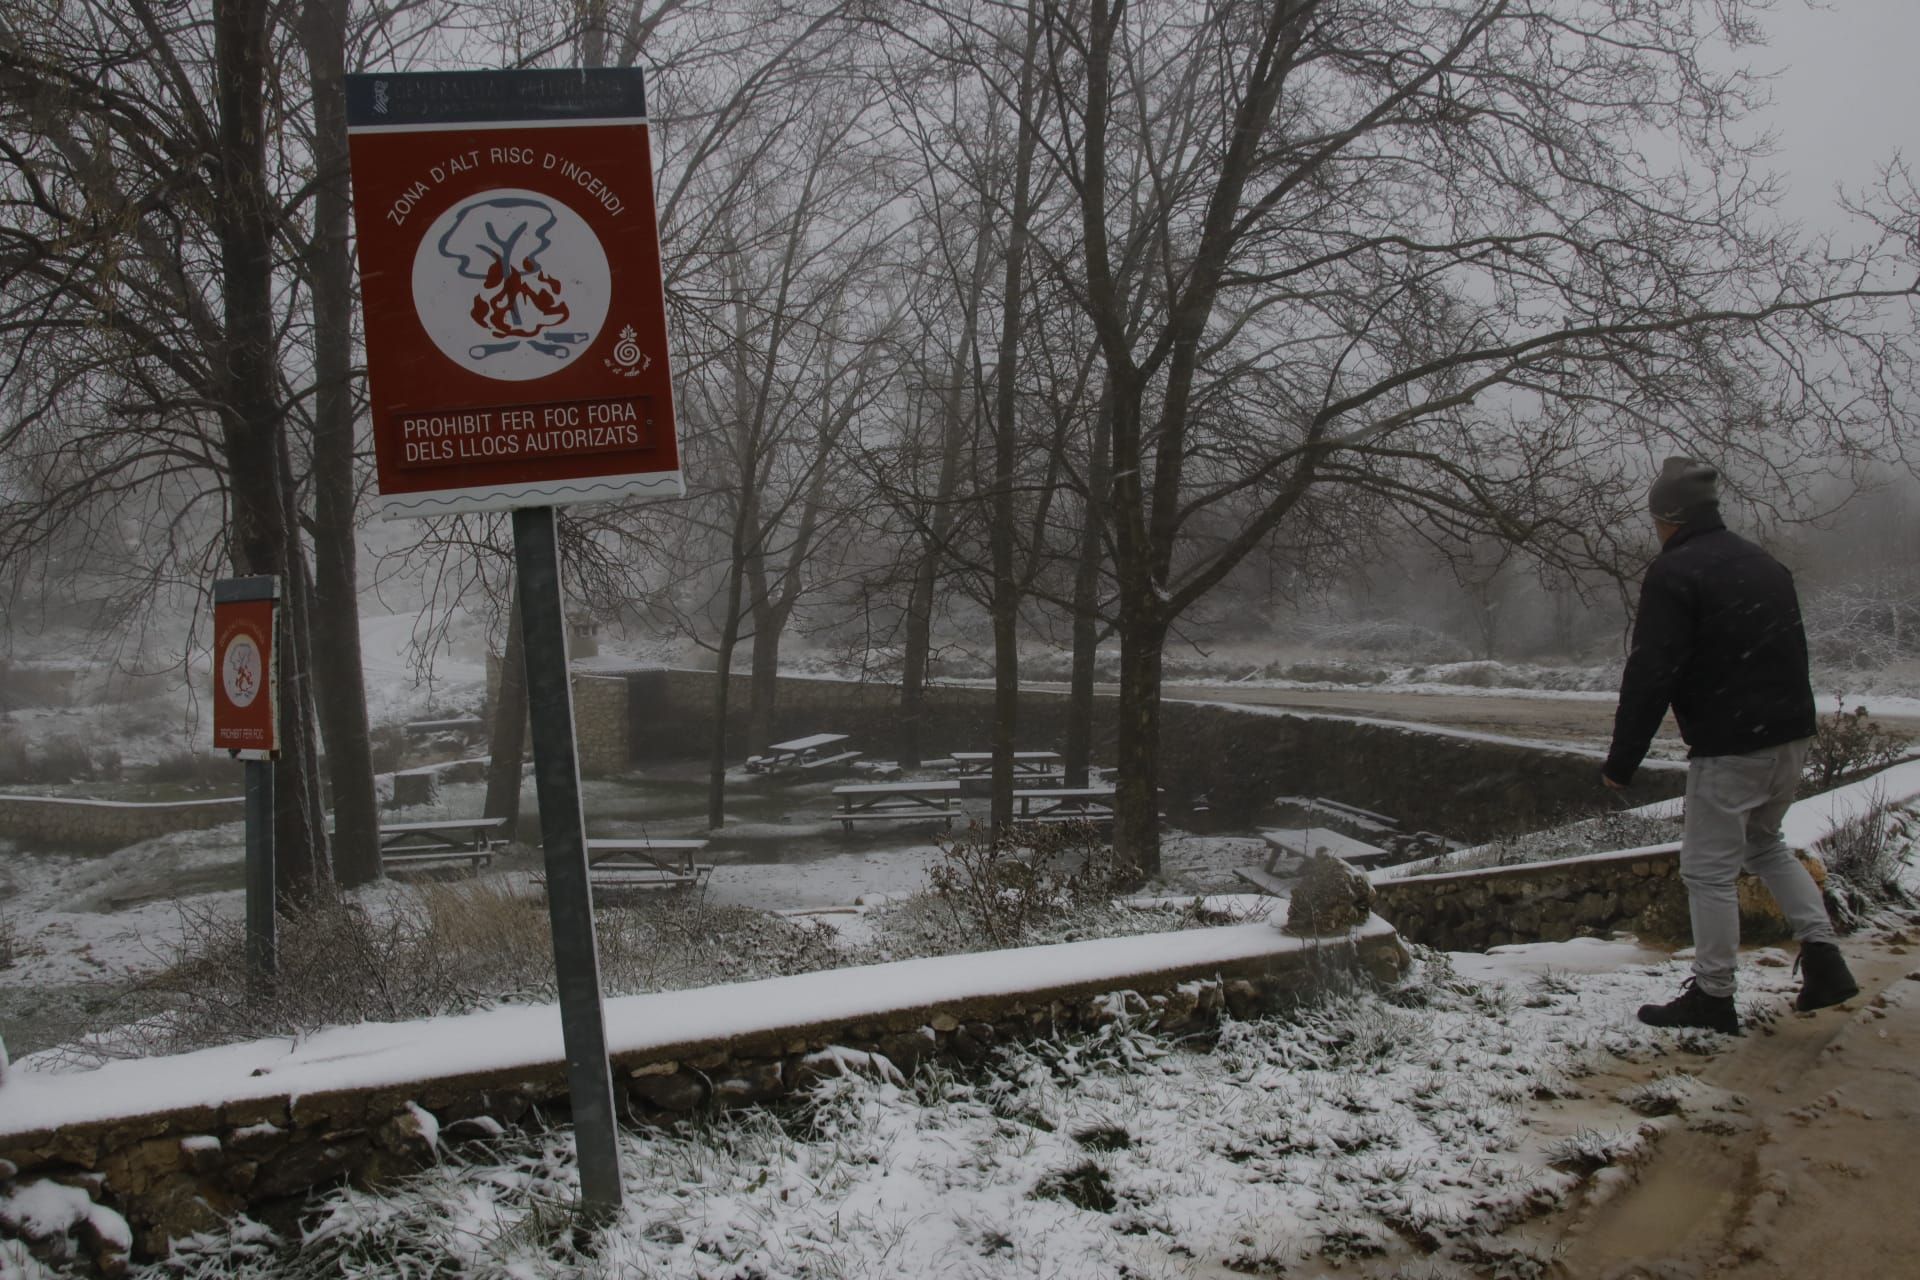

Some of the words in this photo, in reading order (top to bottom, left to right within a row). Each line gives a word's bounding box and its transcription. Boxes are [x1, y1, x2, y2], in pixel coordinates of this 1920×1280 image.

[387, 181, 430, 226] ZONA
[430, 150, 480, 183] D'ALT
[490, 147, 534, 164] RISC
[543, 152, 625, 217] D'INCENDI
[404, 413, 492, 439] PROHIBIT
[500, 410, 536, 431] FER
[544, 407, 579, 428] FOC
[588, 402, 637, 423] FORA
[405, 439, 454, 462] DELS
[459, 435, 519, 458] LLOCS
[525, 424, 639, 452] AUTORIZATS
